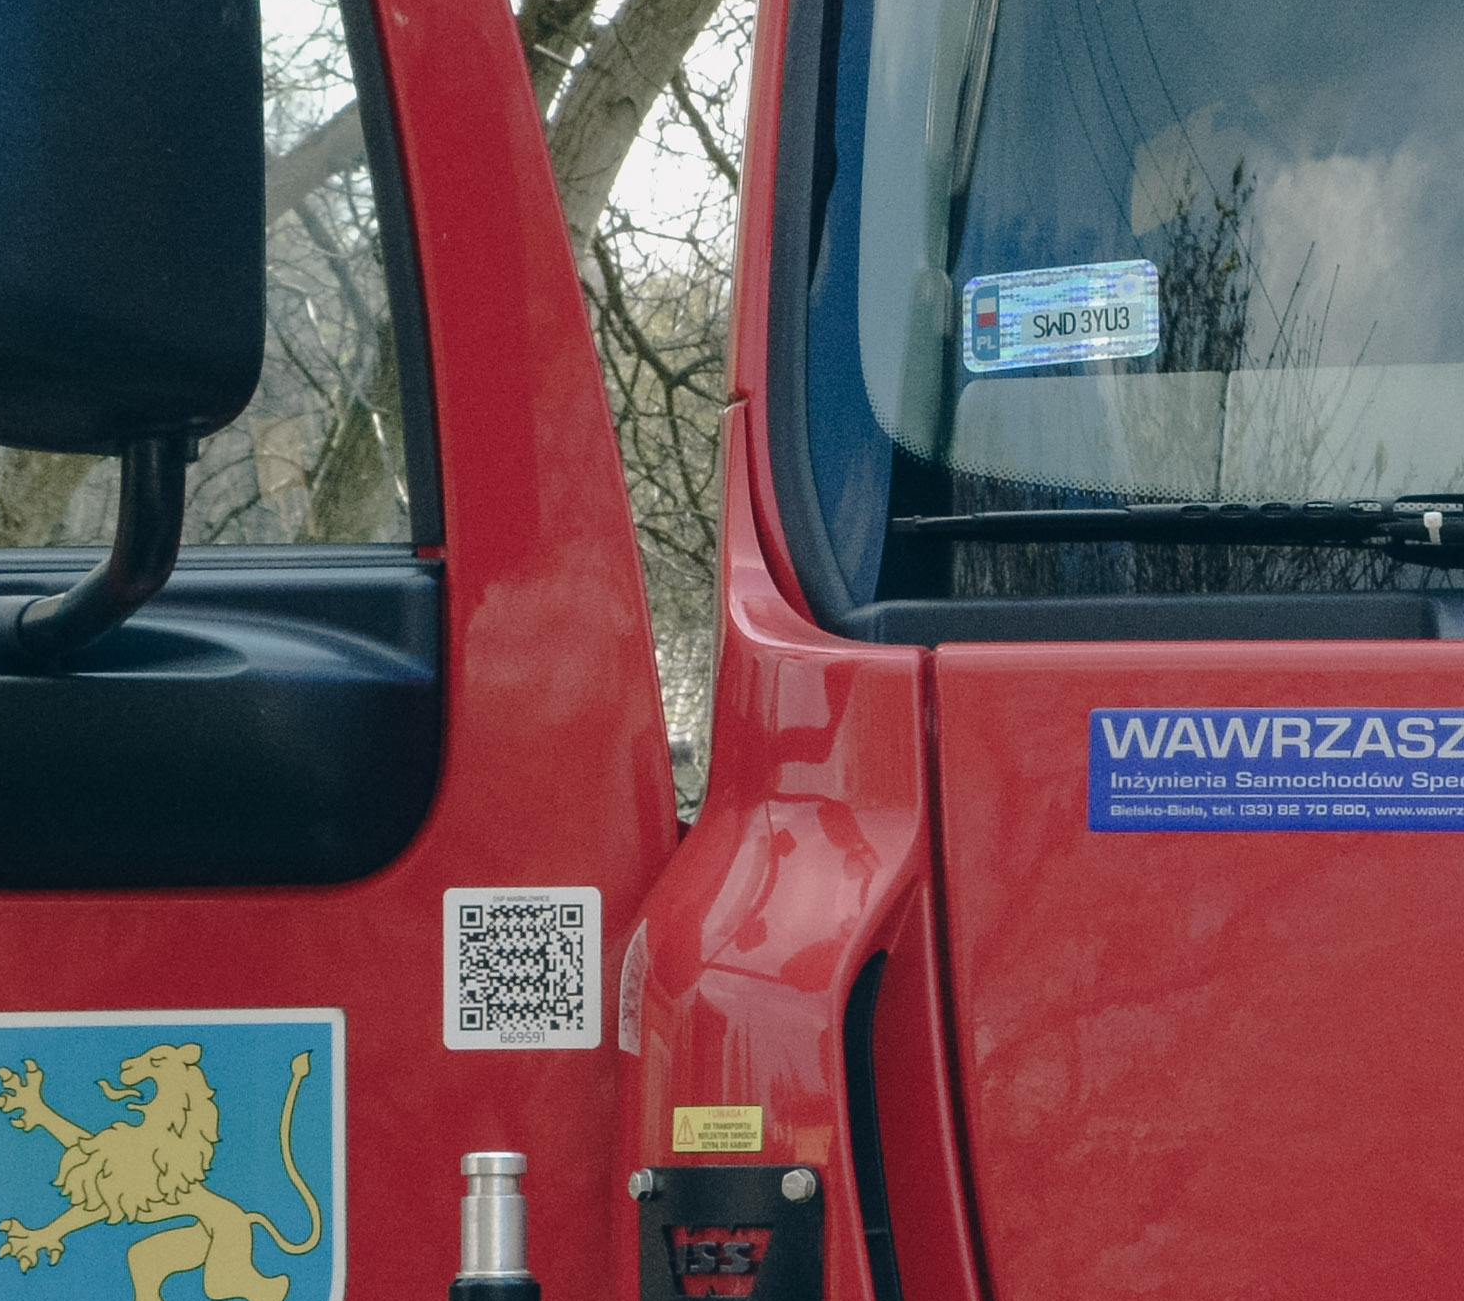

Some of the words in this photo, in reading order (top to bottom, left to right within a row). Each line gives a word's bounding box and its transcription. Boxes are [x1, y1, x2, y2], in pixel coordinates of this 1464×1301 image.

[1032, 310, 1077, 339] SWD
[1080, 306, 1131, 334] 3YU3
[976, 335, 996, 351] PL
[1111, 771, 1227, 792] Inżynieria
[1235, 771, 1403, 788] Samochodów
[1212, 805, 1235, 816] tel.
[1239, 804, 1273, 817] (33)
[1277, 805, 1300, 815] 82
[1306, 805, 1328, 815] 70
[1332, 805, 1370, 818] 800,
[500, 1031, 546, 1043] 669591
